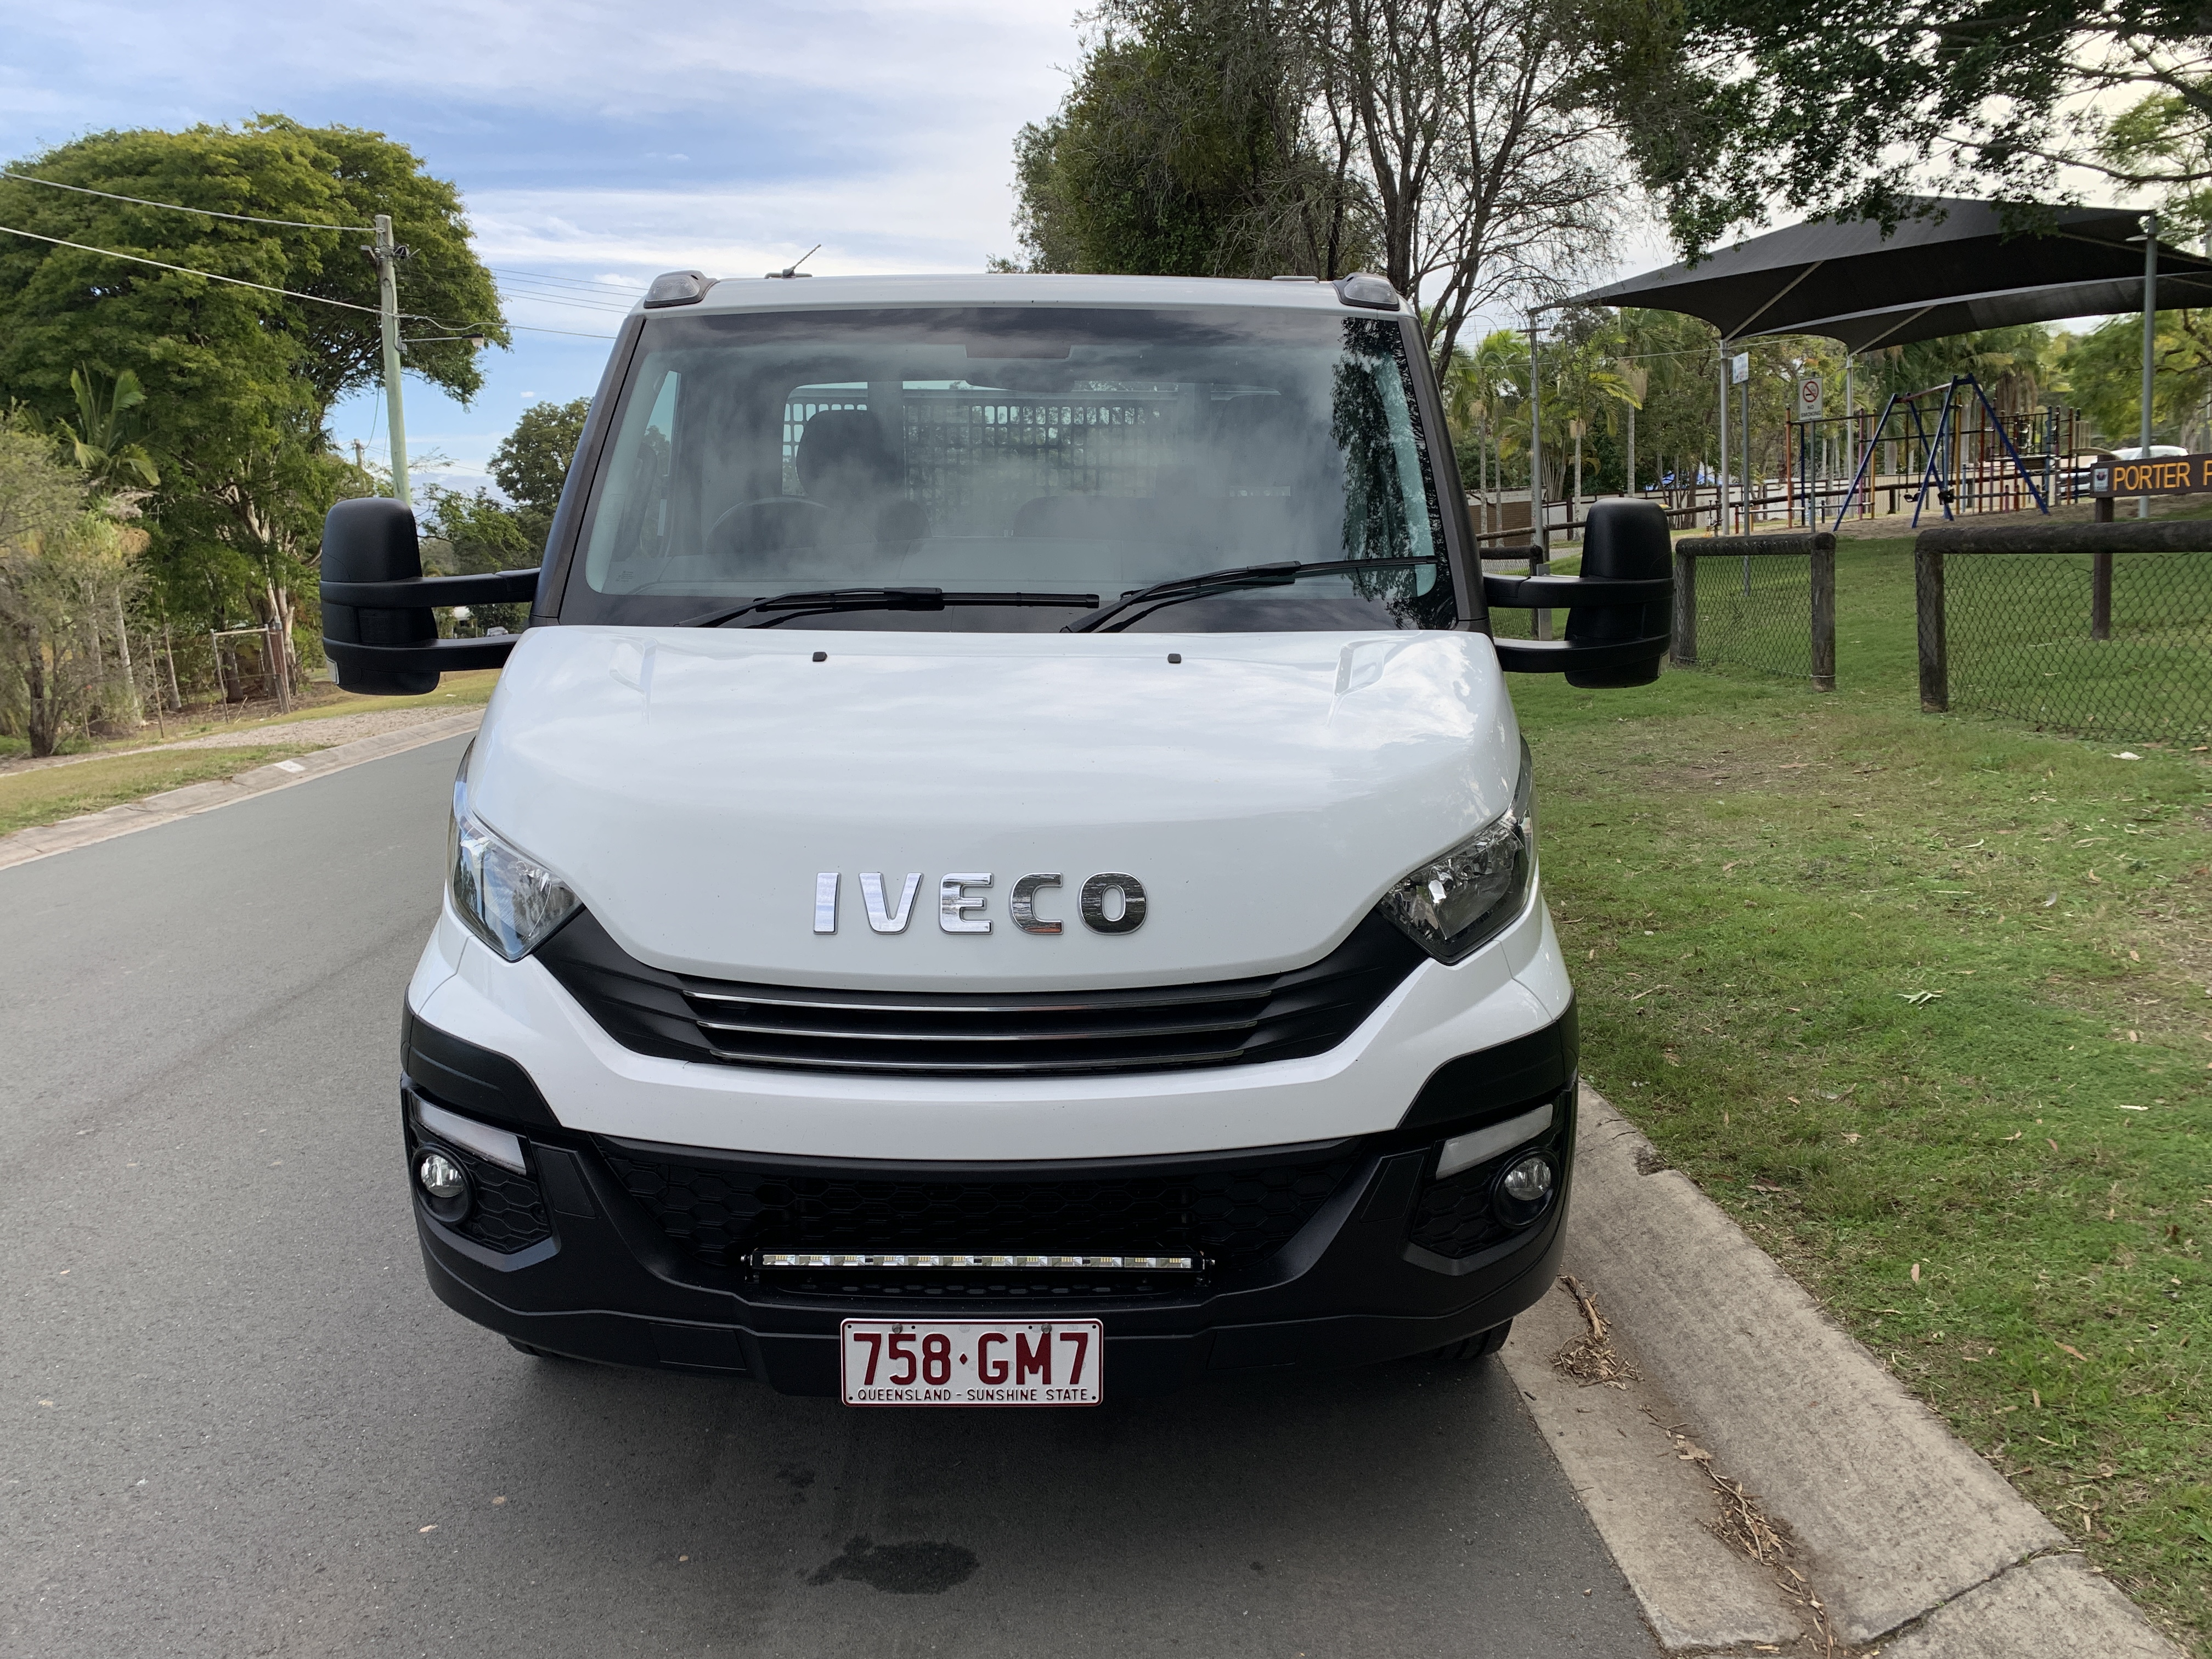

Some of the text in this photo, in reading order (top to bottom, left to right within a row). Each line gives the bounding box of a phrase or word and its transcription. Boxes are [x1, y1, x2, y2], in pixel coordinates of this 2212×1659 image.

[2113, 462, 2191, 490] PORTER
[813, 871, 1148, 935] IVECO
[857, 1388, 951, 1401] QUEENSLAND
[967, 1387, 1037, 1401] SUNSHINE
[1046, 1388, 1088, 1401] STATE
